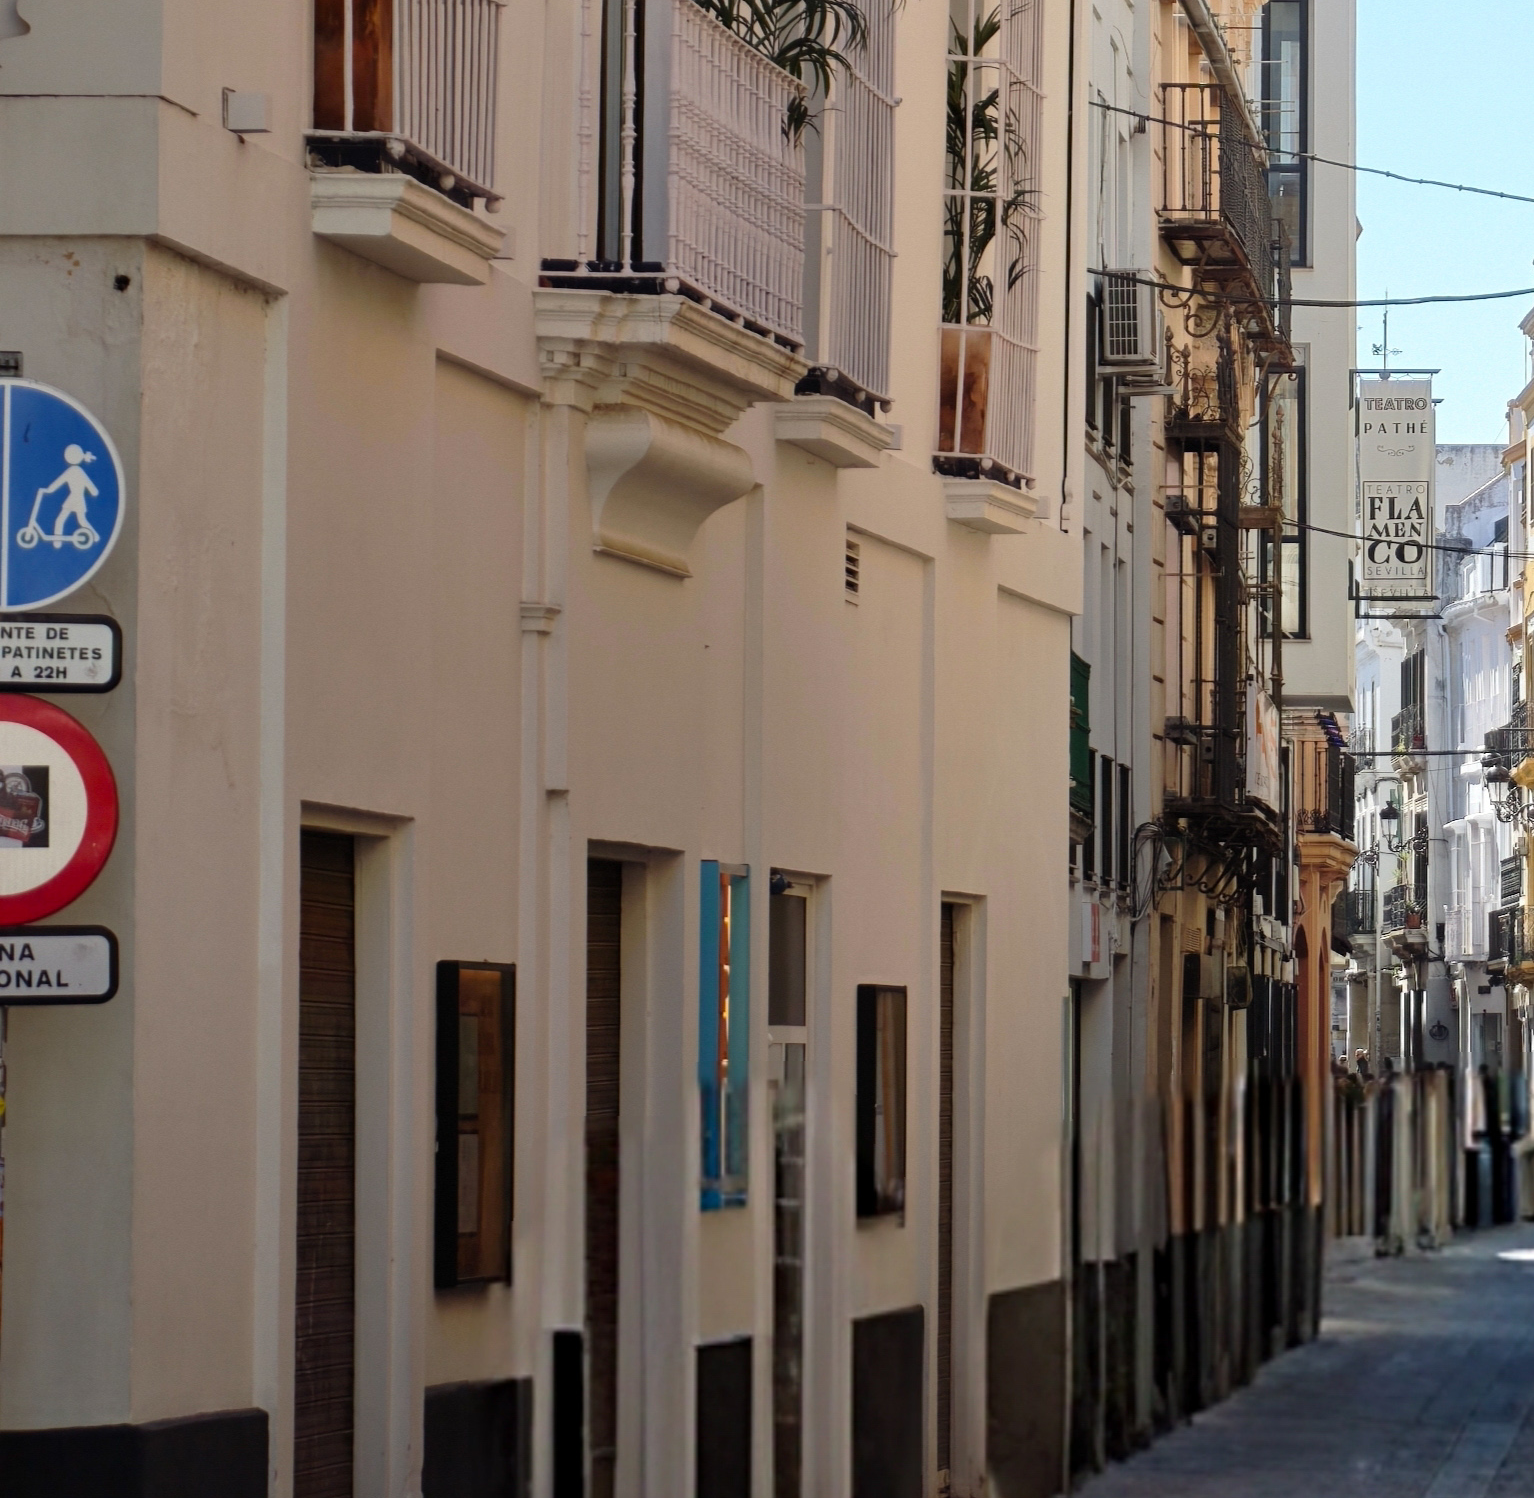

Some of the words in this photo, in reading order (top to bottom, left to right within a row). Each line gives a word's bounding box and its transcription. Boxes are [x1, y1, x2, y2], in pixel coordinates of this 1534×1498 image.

[1364, 397, 1428, 411] TEATRO
[1363, 420, 1429, 434] PATHÉ
[1366, 484, 1426, 495] TEATRO
[1367, 496, 1425, 520] FLA
[1366, 522, 1424, 538] MEN
[1367, 538, 1424, 564] CO
[1366, 566, 1425, 576] SEVILLA
[46, 627, 69, 640] DE
[1, 645, 103, 660] PATINETES
[11, 665, 22, 678] A
[34, 666, 67, 679] 22H
